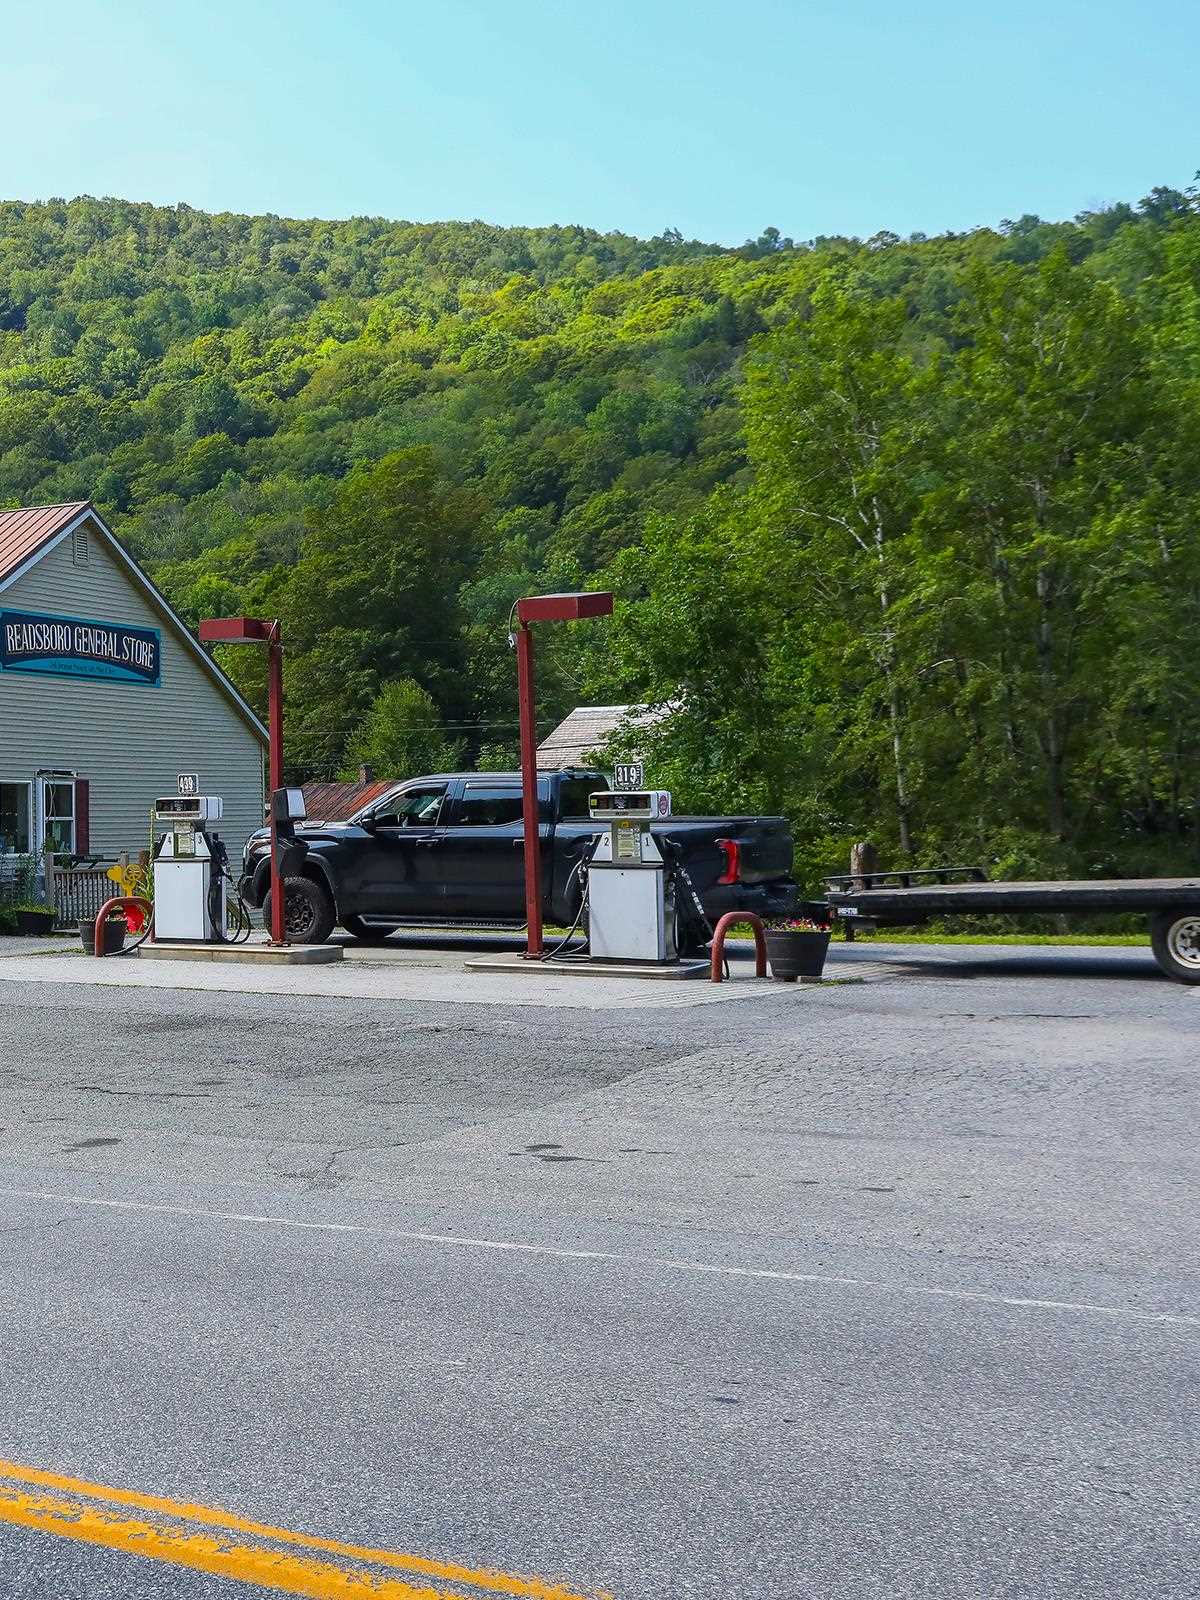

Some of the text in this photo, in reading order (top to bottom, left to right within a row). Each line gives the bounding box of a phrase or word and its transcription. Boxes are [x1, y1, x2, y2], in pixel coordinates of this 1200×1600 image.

[6, 624, 155, 669] READSBORO GENERAL STORE
[617, 766, 637, 784] 319
